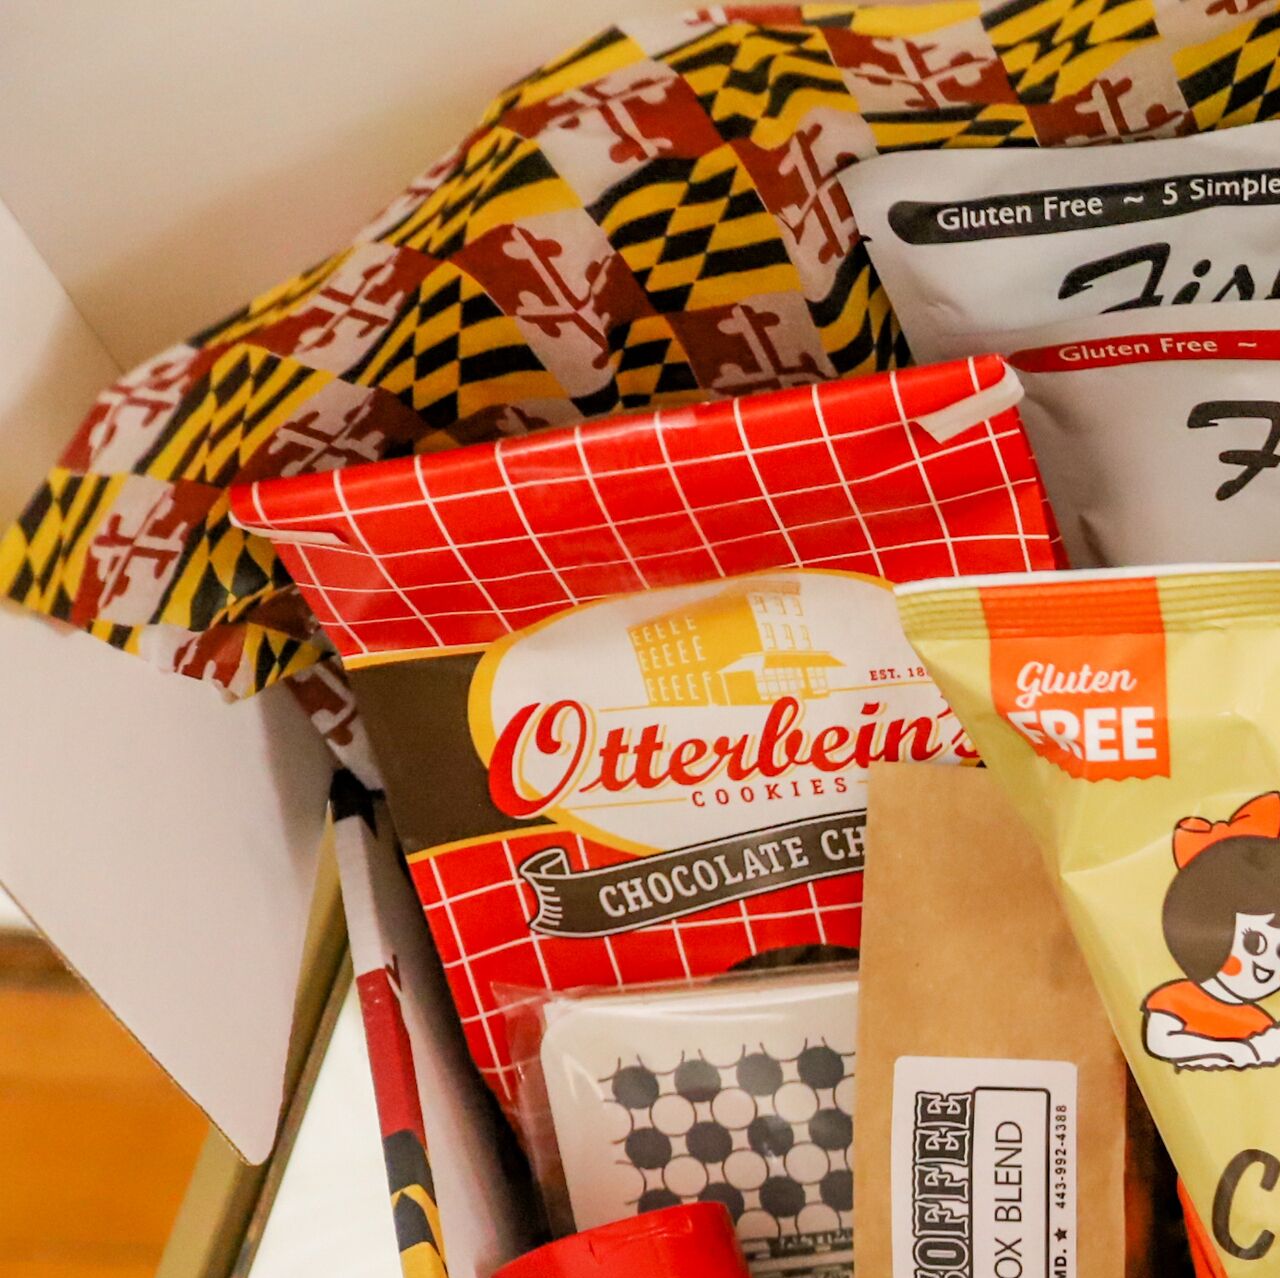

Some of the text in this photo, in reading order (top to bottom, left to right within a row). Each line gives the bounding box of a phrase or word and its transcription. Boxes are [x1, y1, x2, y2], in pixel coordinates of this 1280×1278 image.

[936, 204, 1032, 231] Gluten
[1043, 195, 1103, 220] Free
[1162, 183, 1178, 206] 5
[1058, 340, 1150, 362] Gluten
[1160, 337, 1218, 353] Free
[869, 666, 926, 681] EST. 18
[1015, 661, 1137, 709] Gluten
[1007, 706, 1157, 762] FREE
[691, 775, 848, 808] COOKIES
[599, 826, 866, 919] CHOCOLATE CH
[994, 1121, 1024, 1223] BLEND
